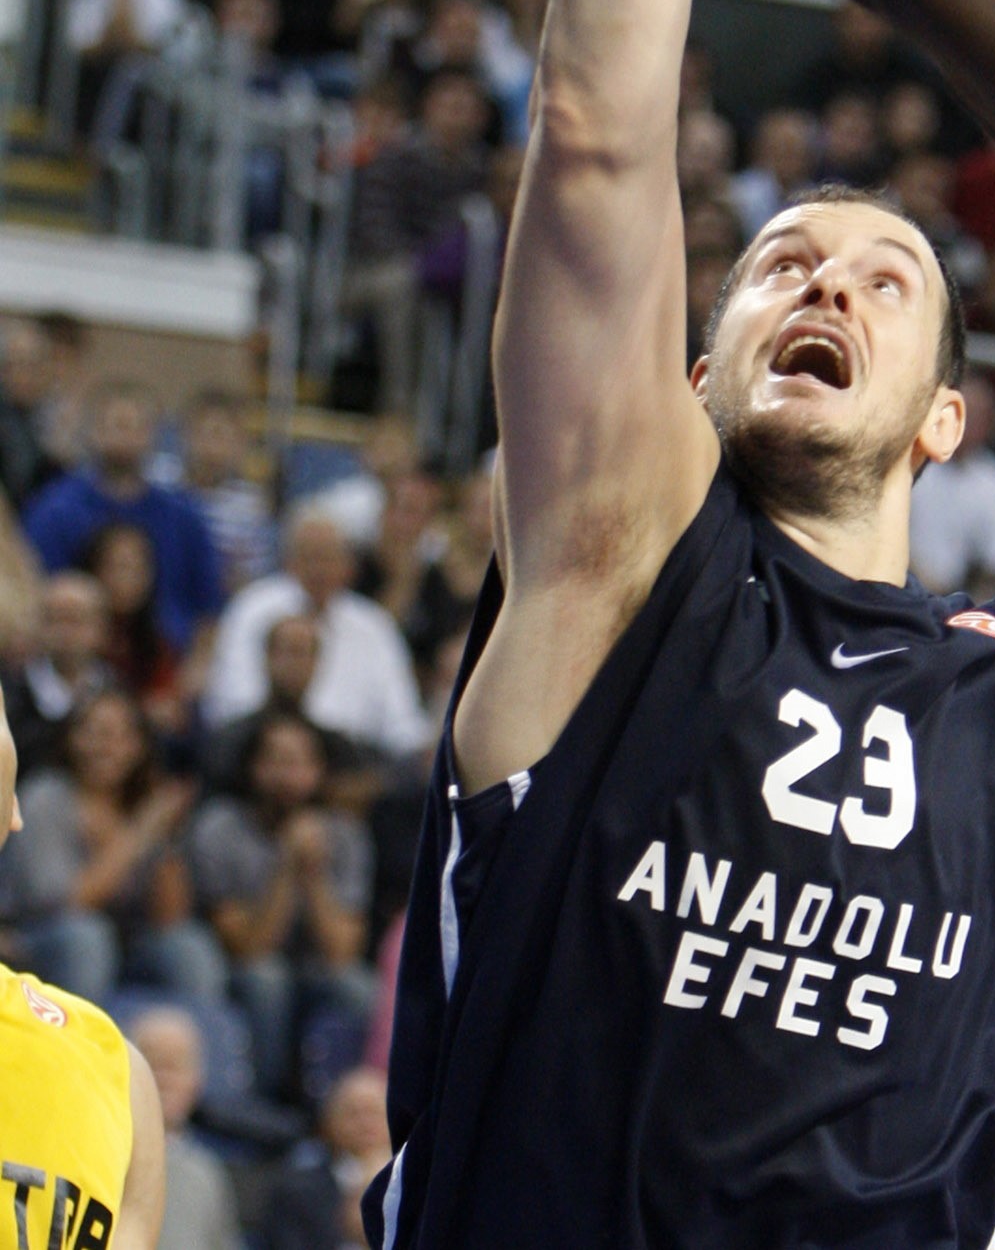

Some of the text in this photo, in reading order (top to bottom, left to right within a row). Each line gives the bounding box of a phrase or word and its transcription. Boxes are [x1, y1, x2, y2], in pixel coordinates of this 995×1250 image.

[762, 688, 917, 850] 23
[617, 840, 972, 980] ANADOLU
[663, 931, 898, 1051] EFES
